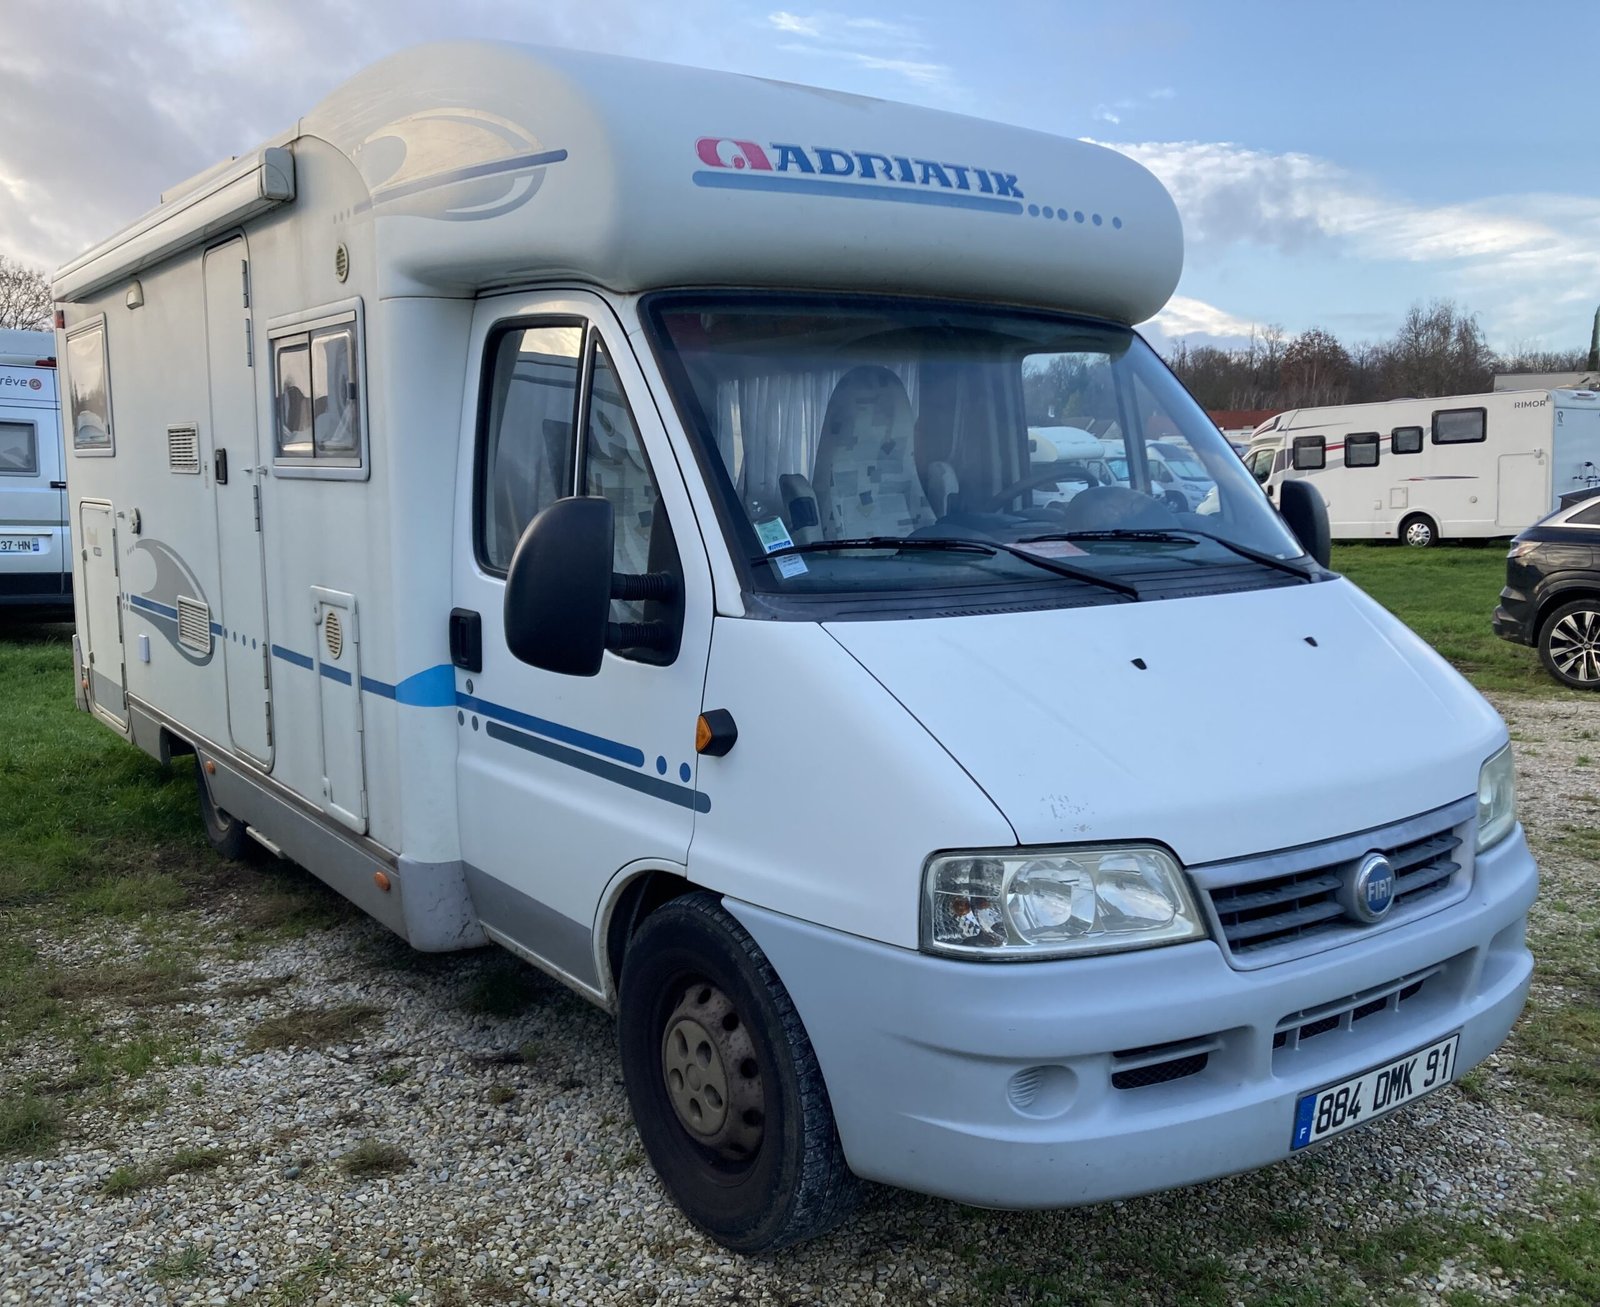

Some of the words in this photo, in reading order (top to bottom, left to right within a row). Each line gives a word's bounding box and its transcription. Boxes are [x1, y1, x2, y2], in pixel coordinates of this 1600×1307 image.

[769, 142, 1025, 199] ADRIATIK
[1514, 400, 1546, 409] RIMOR
[1367, 876, 1392, 902] FIAT
[1315, 1081, 1364, 1135] 884
[1372, 1057, 1419, 1112] DMK
[1423, 1042, 1452, 1088] 91
[1299, 1126, 1308, 1140] F
